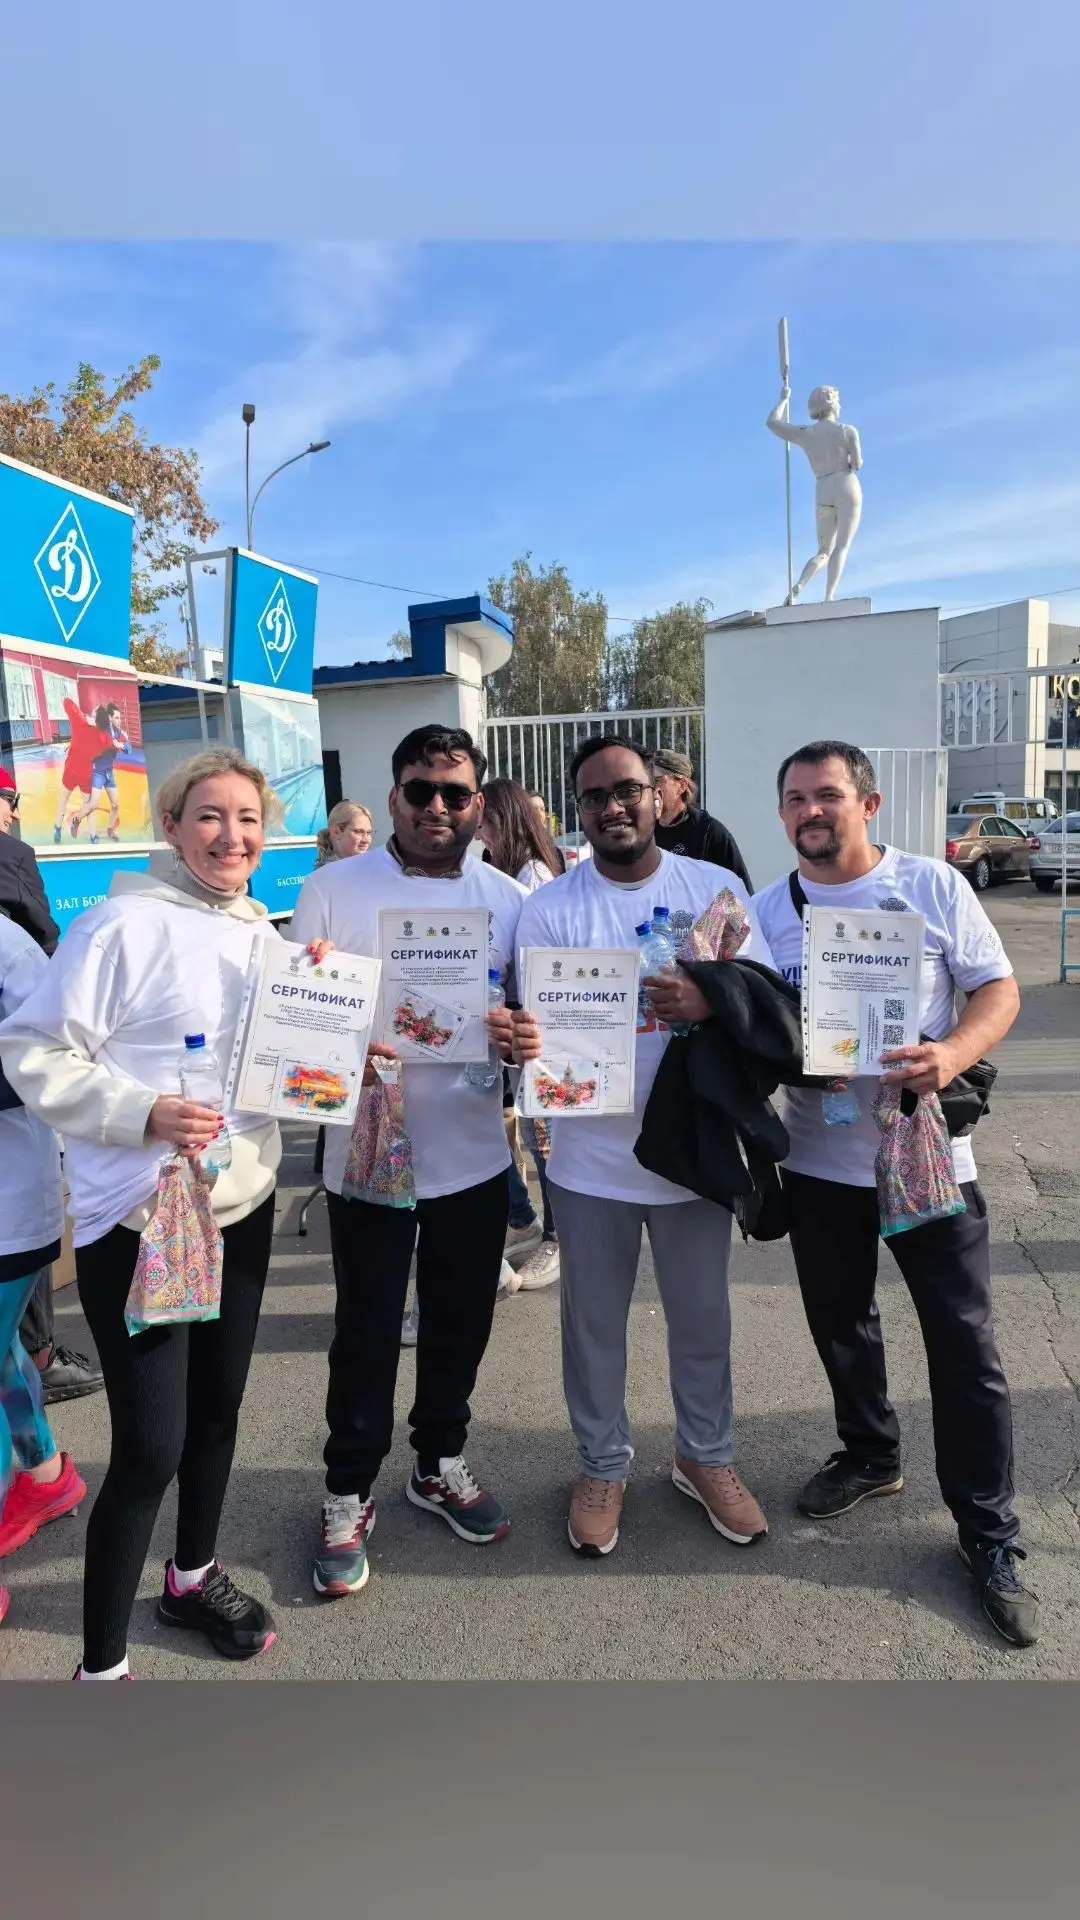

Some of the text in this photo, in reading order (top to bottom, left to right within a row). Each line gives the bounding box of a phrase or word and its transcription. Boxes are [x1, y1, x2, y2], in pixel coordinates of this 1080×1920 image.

[55, 897, 79, 910] ЗАЛ
[391, 949, 478, 960] СЕРТИФИКАТ
[822, 951, 911, 967] СЕРТИФИКАТ
[271, 983, 365, 1010] СЕРТИФИКАТ
[538, 991, 627, 1003] СЕРТИФИКАТ
